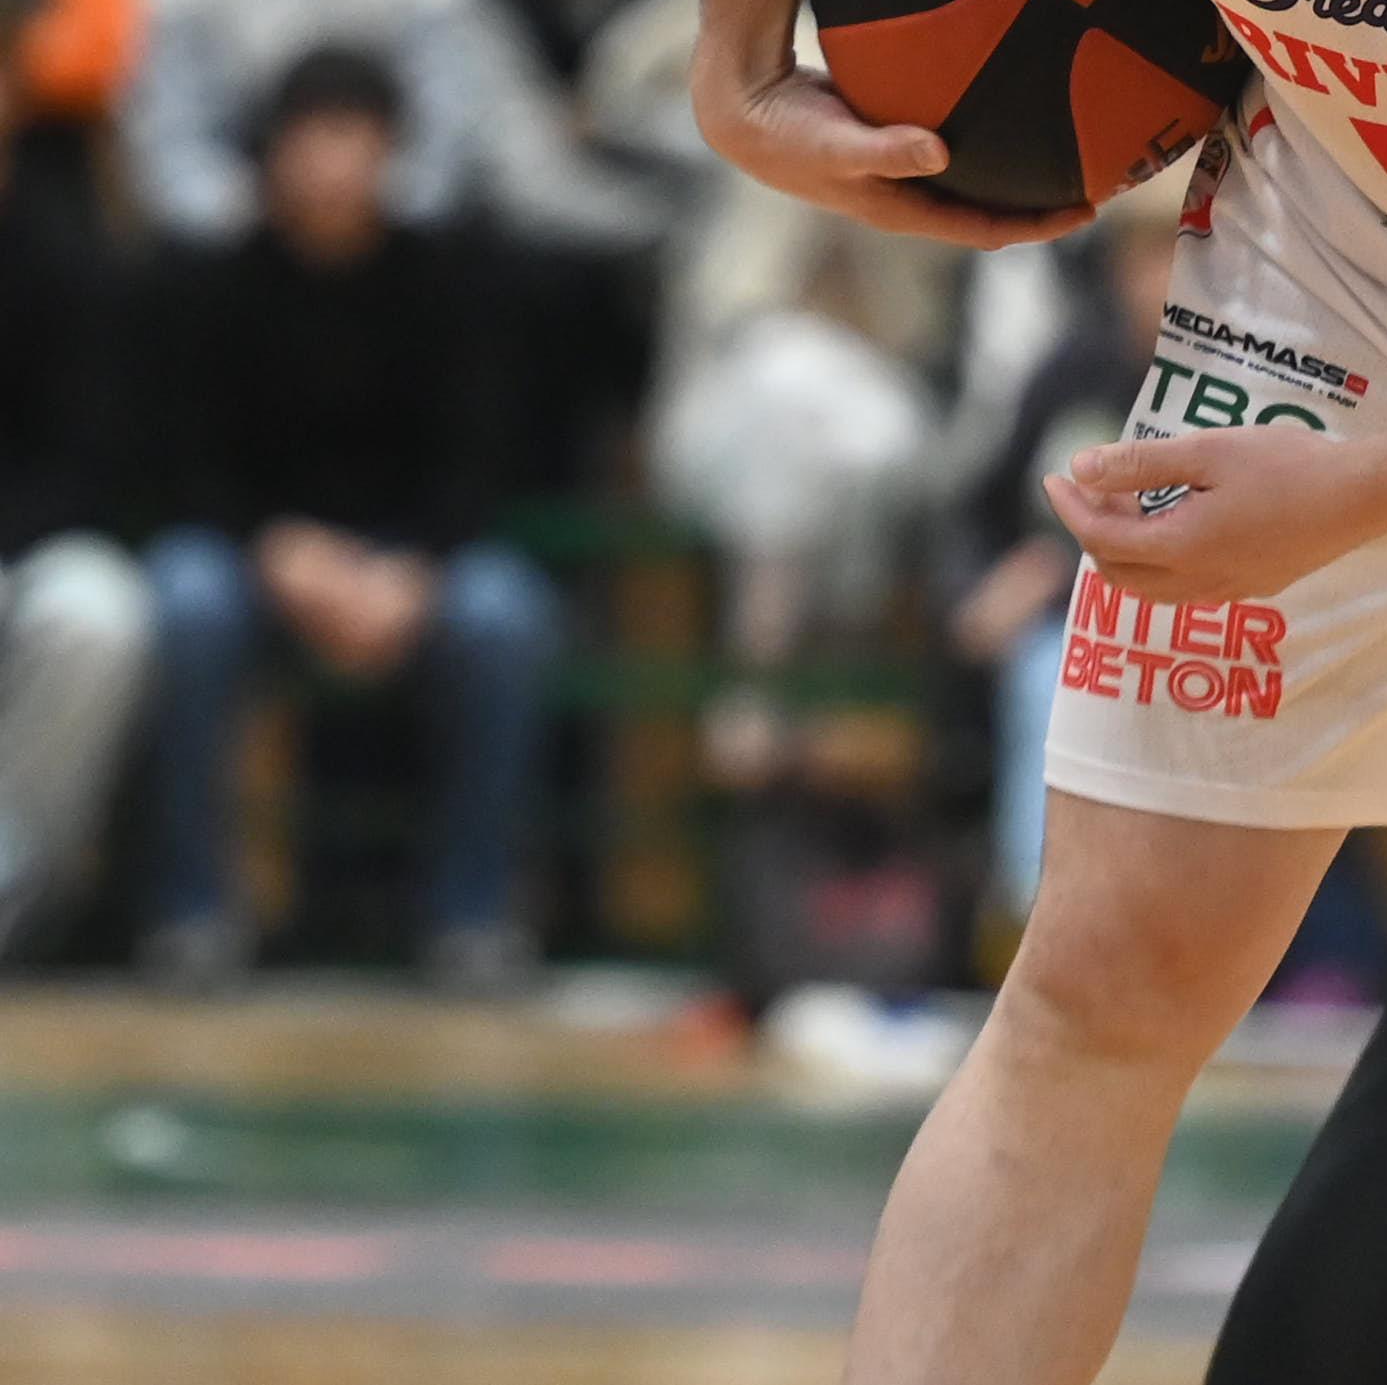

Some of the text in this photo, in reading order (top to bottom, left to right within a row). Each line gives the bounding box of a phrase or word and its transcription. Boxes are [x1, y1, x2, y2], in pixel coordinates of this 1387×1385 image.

[1163, 301, 1348, 388] MEGA-MASS
[1074, 570, 1286, 665] NTER
[1062, 634, 1283, 719] BETON
